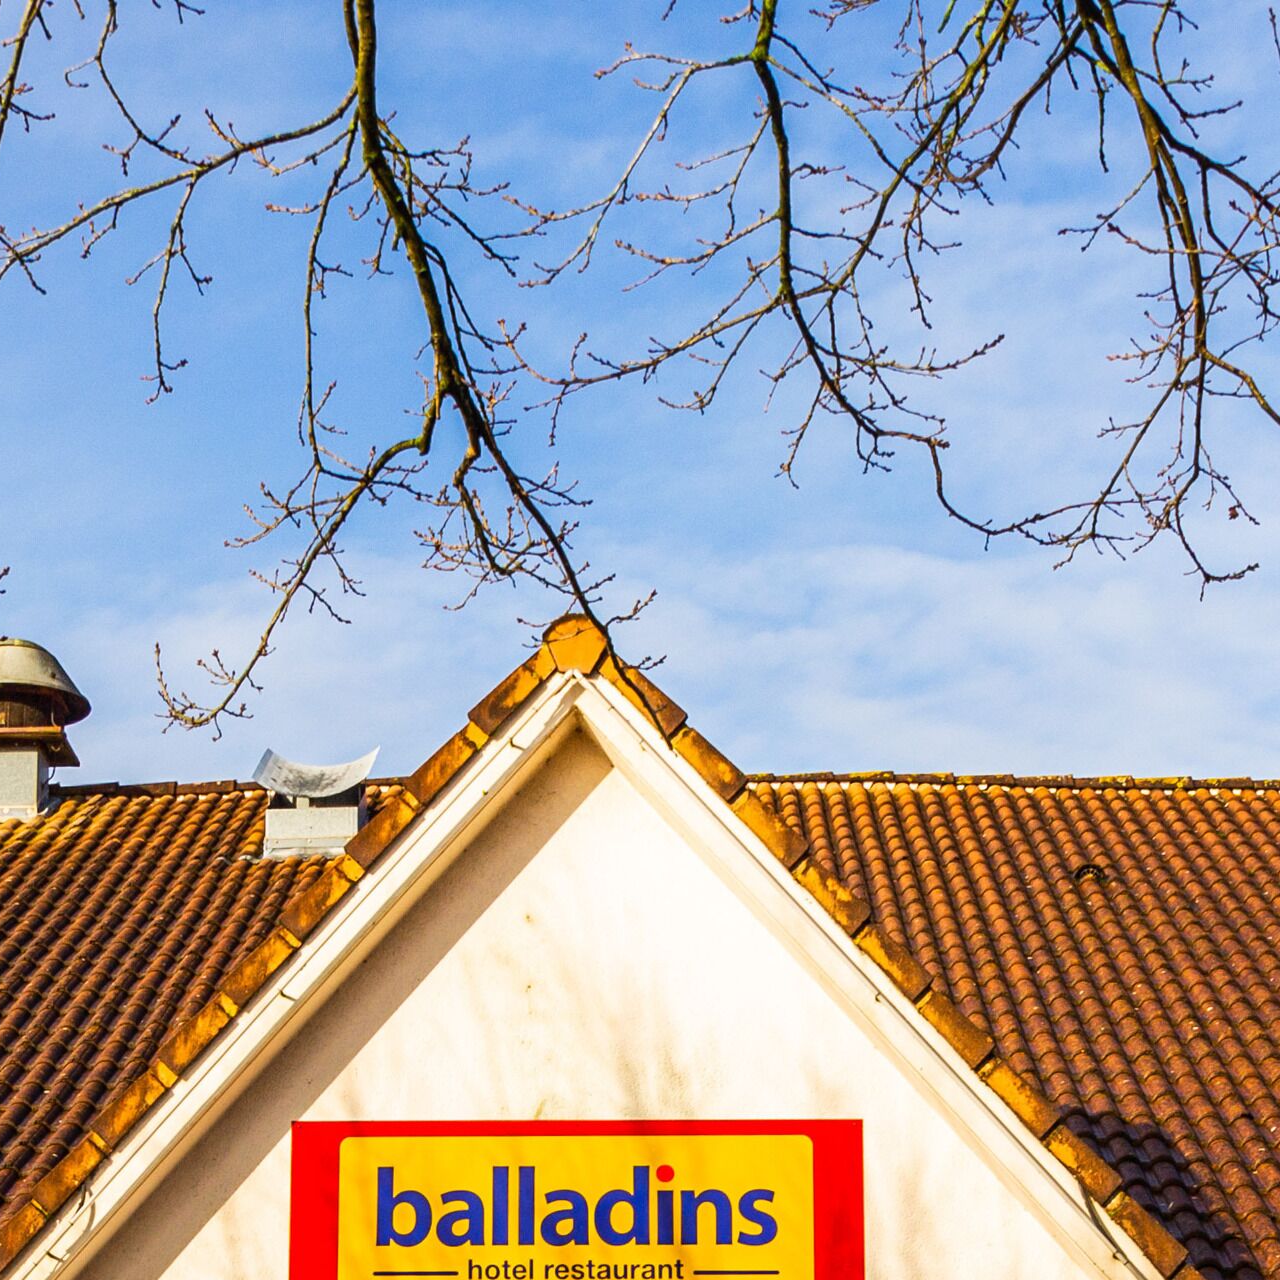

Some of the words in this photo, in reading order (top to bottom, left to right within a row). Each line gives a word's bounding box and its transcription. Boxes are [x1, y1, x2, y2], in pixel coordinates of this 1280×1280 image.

[375, 1164, 778, 1247] balladins
[467, 1258, 535, 1280] hotel
[544, 1259, 685, 1280] restaurant
